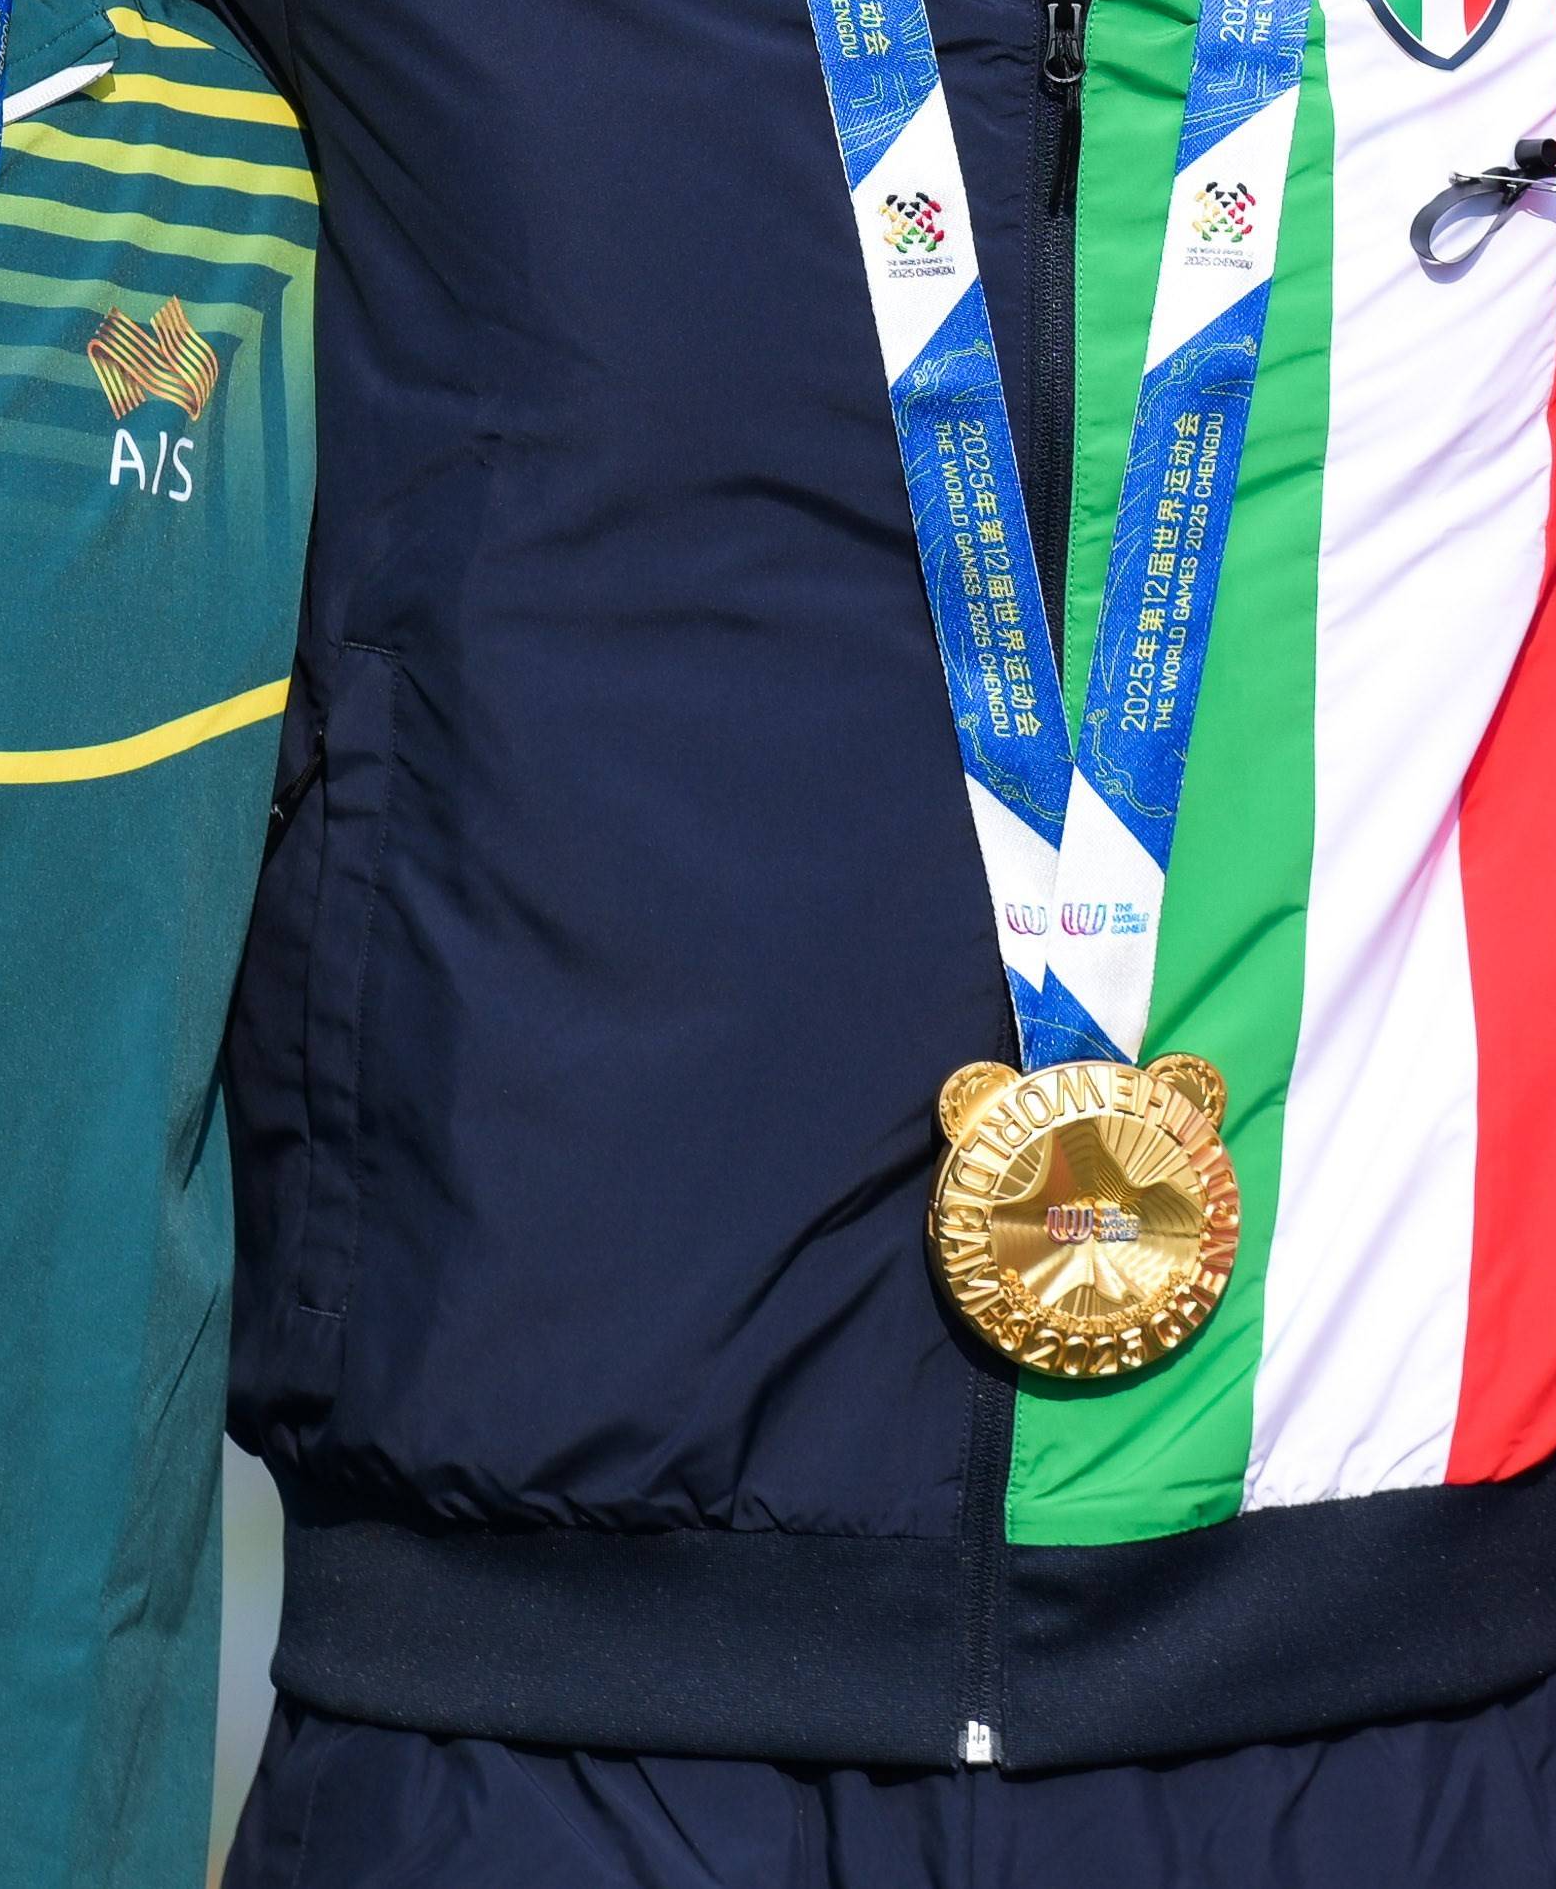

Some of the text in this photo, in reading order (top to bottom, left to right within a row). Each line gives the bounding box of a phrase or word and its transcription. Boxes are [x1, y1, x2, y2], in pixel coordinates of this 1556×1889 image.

[1251, 11, 1274, 44] THE
[933, 420, 1011, 739] THE WORLD GAMES 2025 CHENGDU
[959, 418, 1042, 738] 2025年第12届世界运动会
[1120, 411, 1202, 733] 2025年第12届世界运动会
[1153, 411, 1226, 733] THE WORLD GAMES 2025 CHENGDU
[954, 1068, 1106, 1195] WORLD
